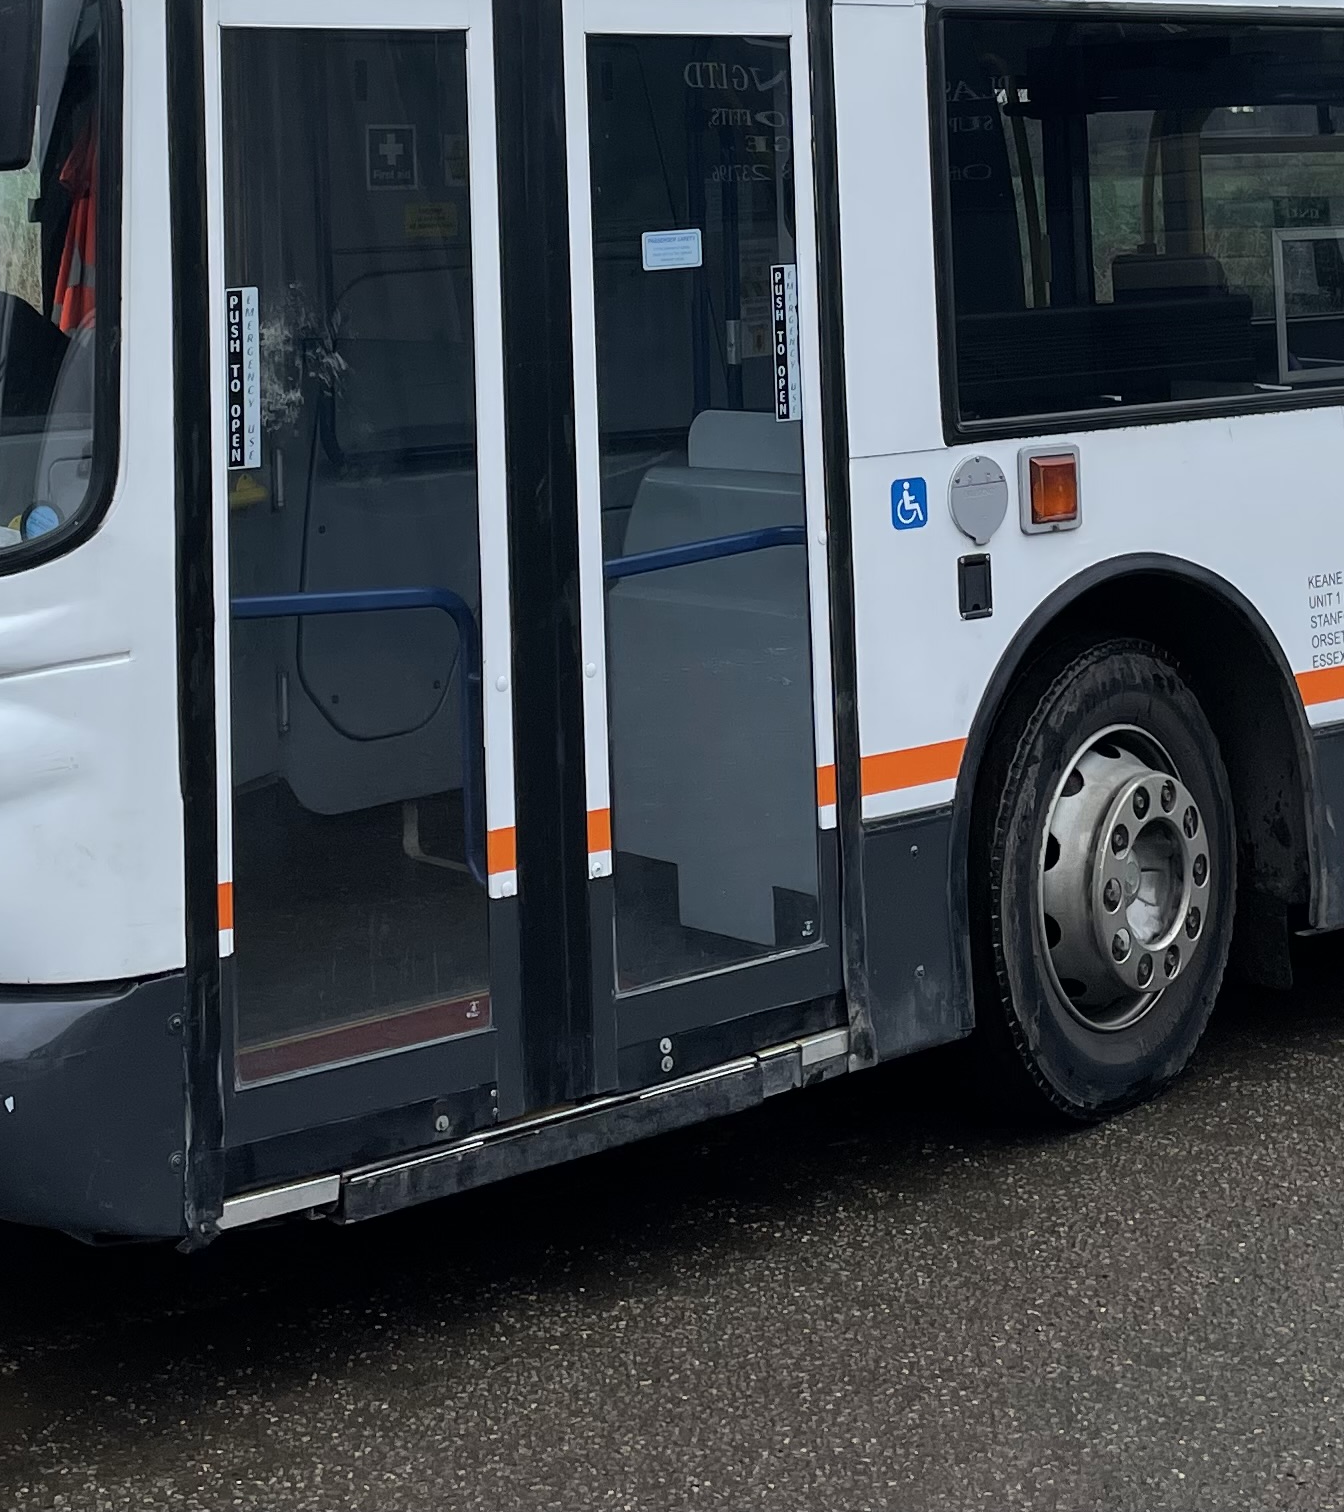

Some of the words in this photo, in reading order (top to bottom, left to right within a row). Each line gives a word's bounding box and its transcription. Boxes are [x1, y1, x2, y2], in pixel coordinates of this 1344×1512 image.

[774, 271, 784, 321] PUSH
[786, 270, 796, 369] EMERGENCY
[229, 295, 241, 353] PUSH
[776, 330, 786, 355] TO
[244, 294, 255, 409] EMERGENCY
[230, 364, 241, 393] TO
[778, 365, 787, 416] OPEN
[231, 404, 242, 463] OPEN
[247, 424, 255, 461] USE
[1308, 571, 1343, 590] KEANE
[1309, 592, 1333, 609] UNIT
[1336, 591, 1341, 605] 1
